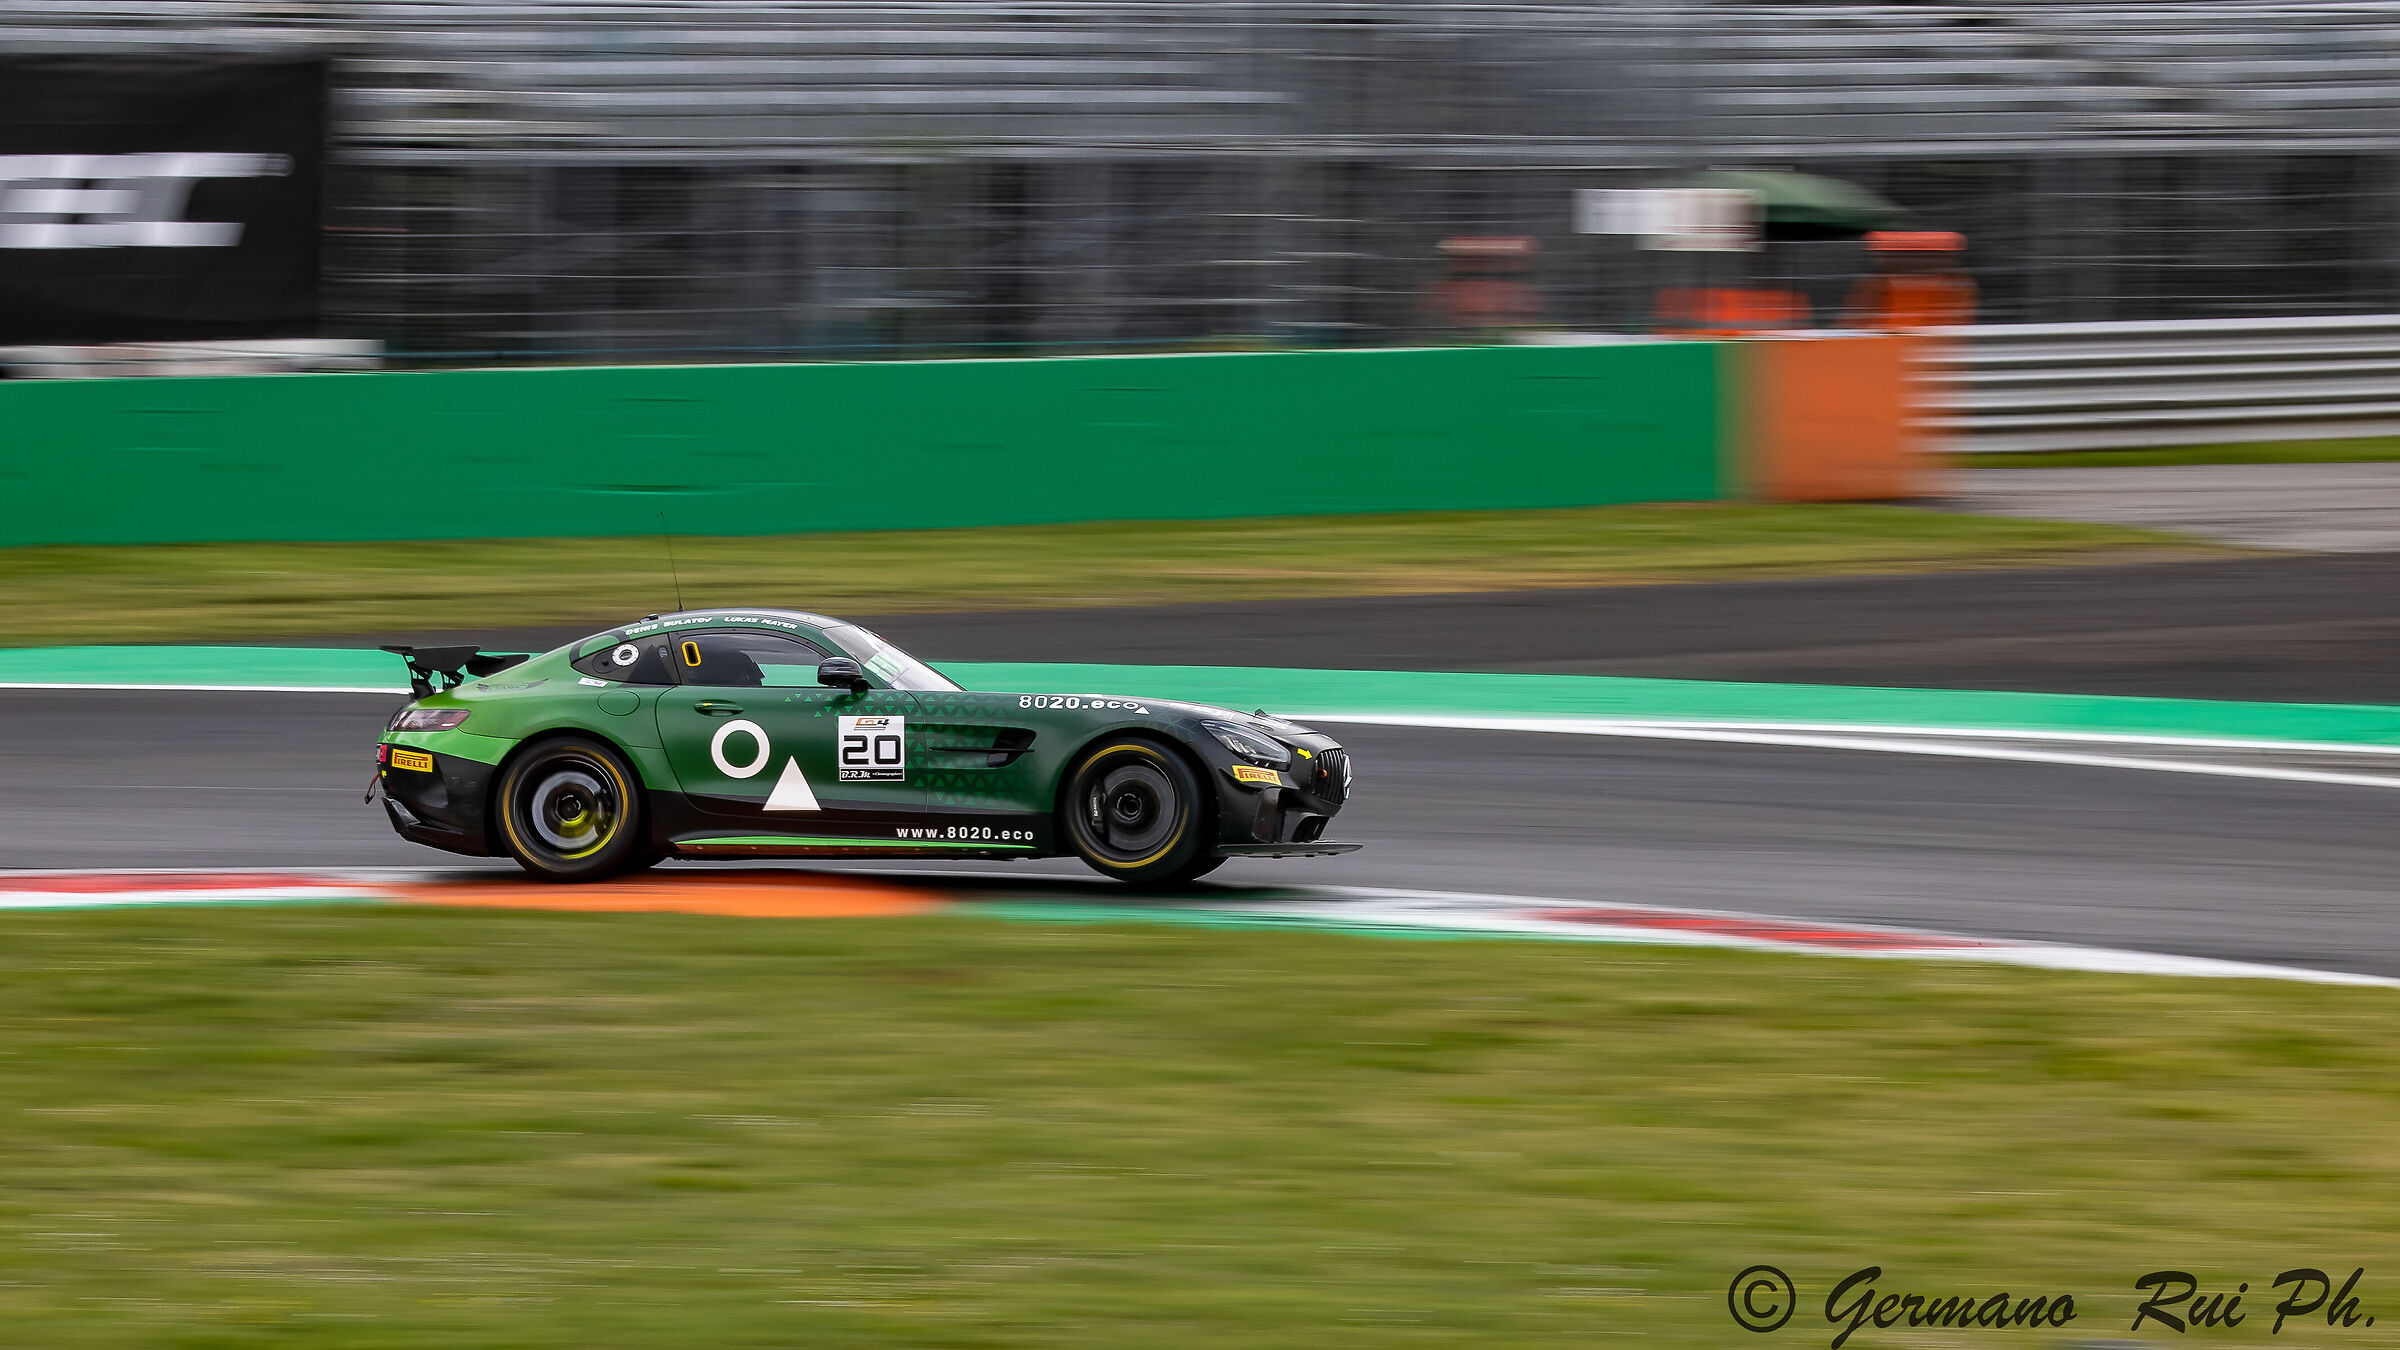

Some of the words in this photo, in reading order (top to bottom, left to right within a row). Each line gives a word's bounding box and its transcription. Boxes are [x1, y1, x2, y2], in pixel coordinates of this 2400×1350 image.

[625, 623, 659, 636] DENIS
[663, 616, 712, 628] BULATOV
[723, 616, 758, 624] LUKAS
[760, 617, 798, 630] MAYER
[1018, 695, 1139, 710] 8020.eco
[842, 735, 901, 765] 20
[394, 752, 428, 769] PIRELLI
[896, 826, 1034, 840] www.8020.eco
